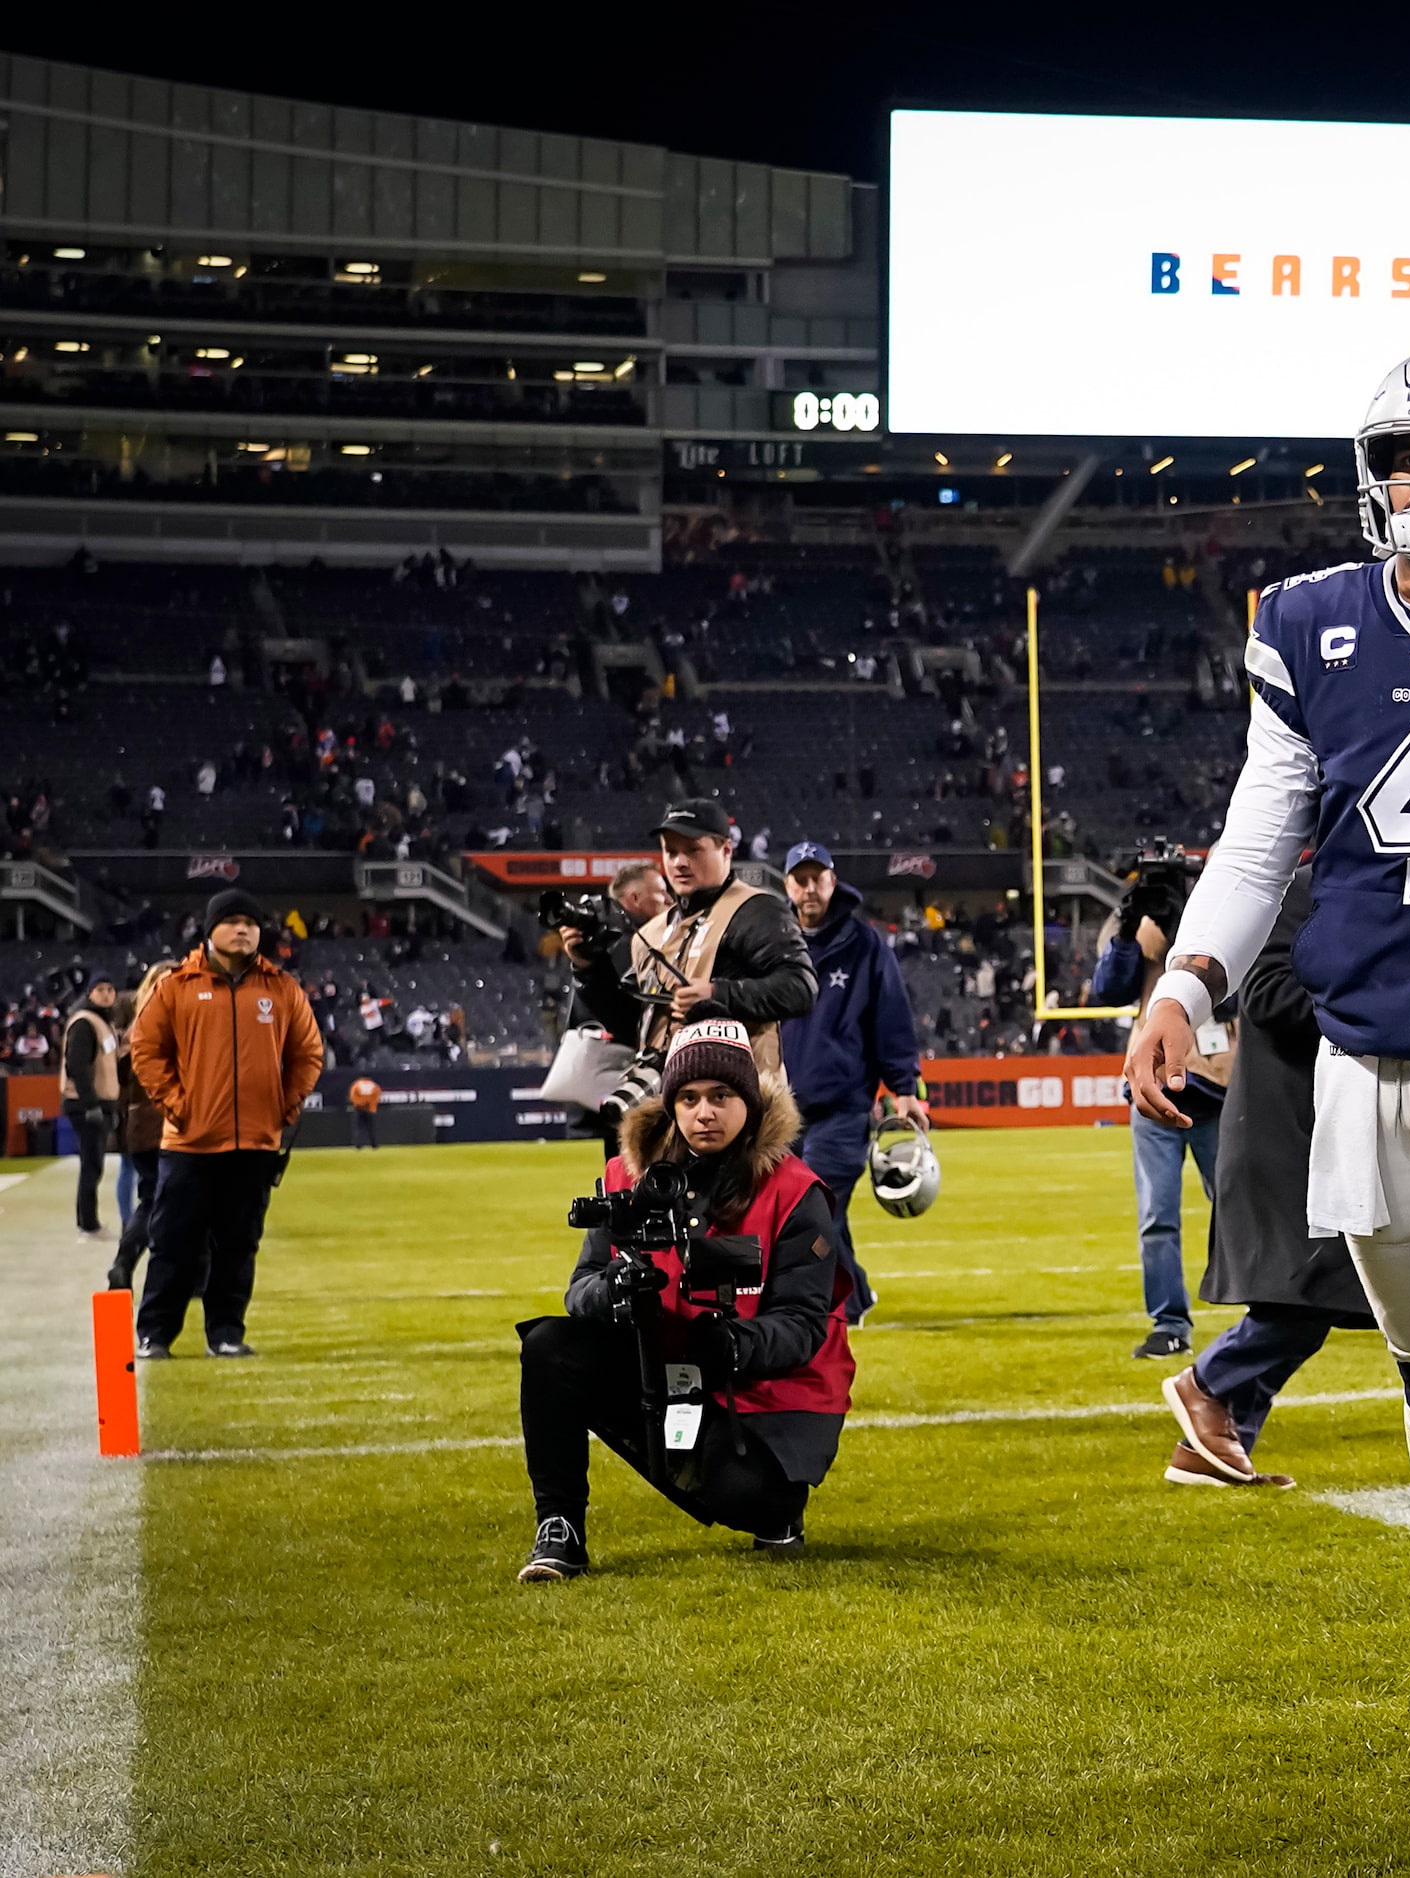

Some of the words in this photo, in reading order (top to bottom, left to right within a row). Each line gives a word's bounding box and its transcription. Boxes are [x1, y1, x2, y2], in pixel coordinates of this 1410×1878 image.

[793, 391, 880, 432] 0:00
[749, 442, 803, 466] LOFT
[1318, 626, 1357, 661] C
[927, 1077, 1064, 1108] CHICAGO
